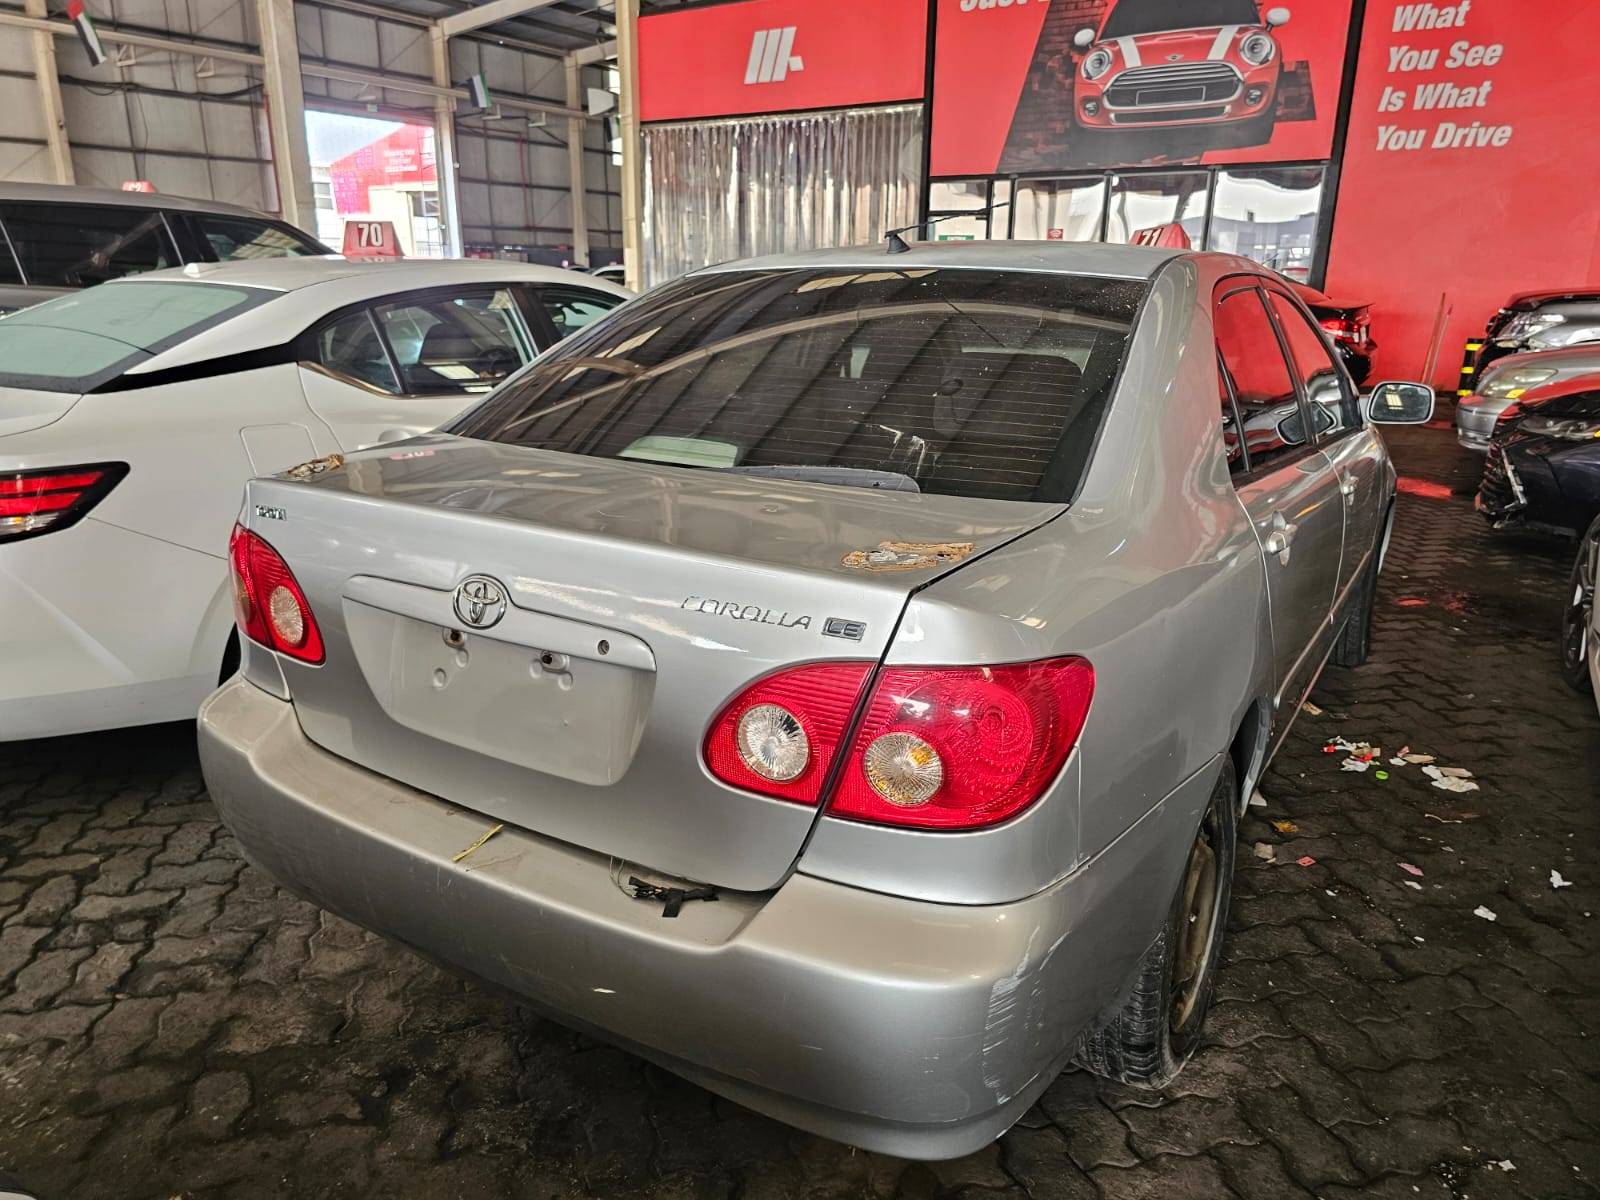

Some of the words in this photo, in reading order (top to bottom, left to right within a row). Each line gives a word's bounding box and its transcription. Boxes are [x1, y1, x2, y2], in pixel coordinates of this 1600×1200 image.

[1392, 0, 1471, 33] What
[1387, 45, 1440, 73] You
[1444, 40, 1504, 69] See
[1377, 85, 1407, 113] Is
[1413, 80, 1493, 111] What
[1376, 124, 1427, 151] You
[1431, 121, 1513, 149] Drive
[358, 223, 383, 247] 70
[1140, 228, 1162, 246] 71
[680, 595, 812, 630] COROLLA
[826, 618, 864, 639] LE
